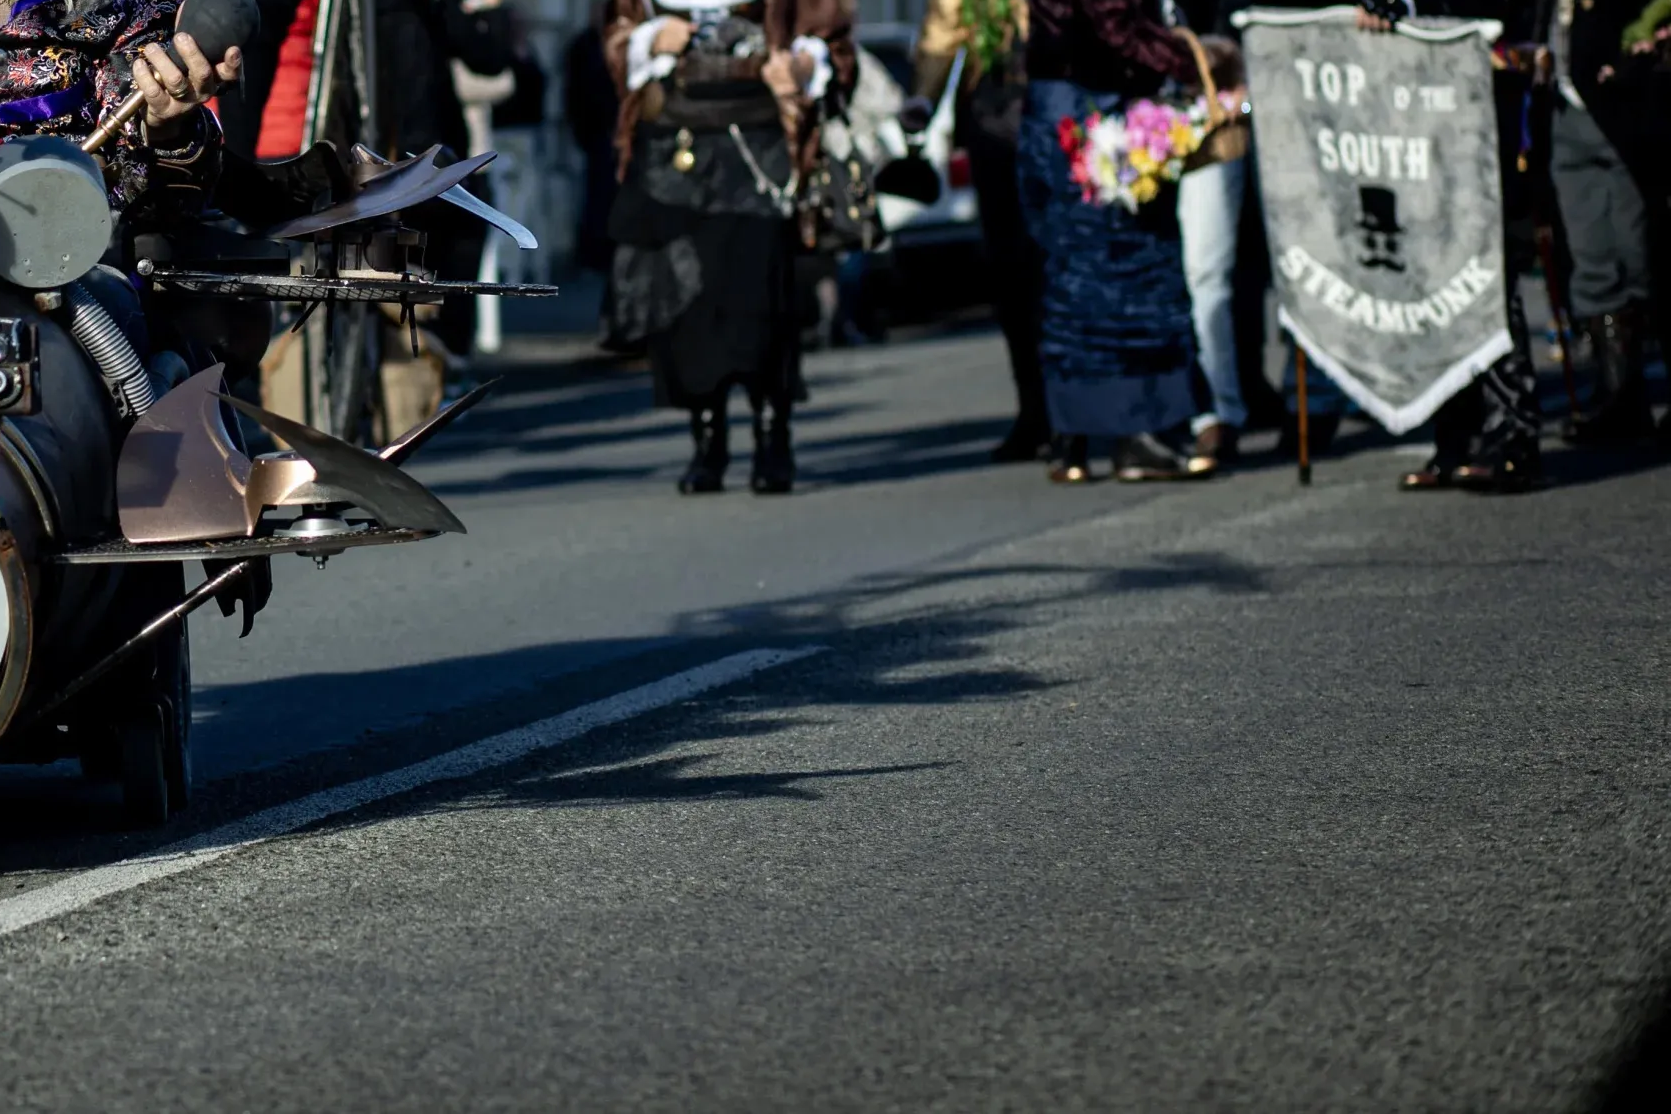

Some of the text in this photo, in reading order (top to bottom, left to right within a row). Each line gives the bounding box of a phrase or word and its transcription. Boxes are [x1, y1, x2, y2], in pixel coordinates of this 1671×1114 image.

[1295, 59, 1365, 106] TOP
[1318, 127, 1429, 180] SOUTH
[1279, 245, 1496, 334] STEAMPUNK
